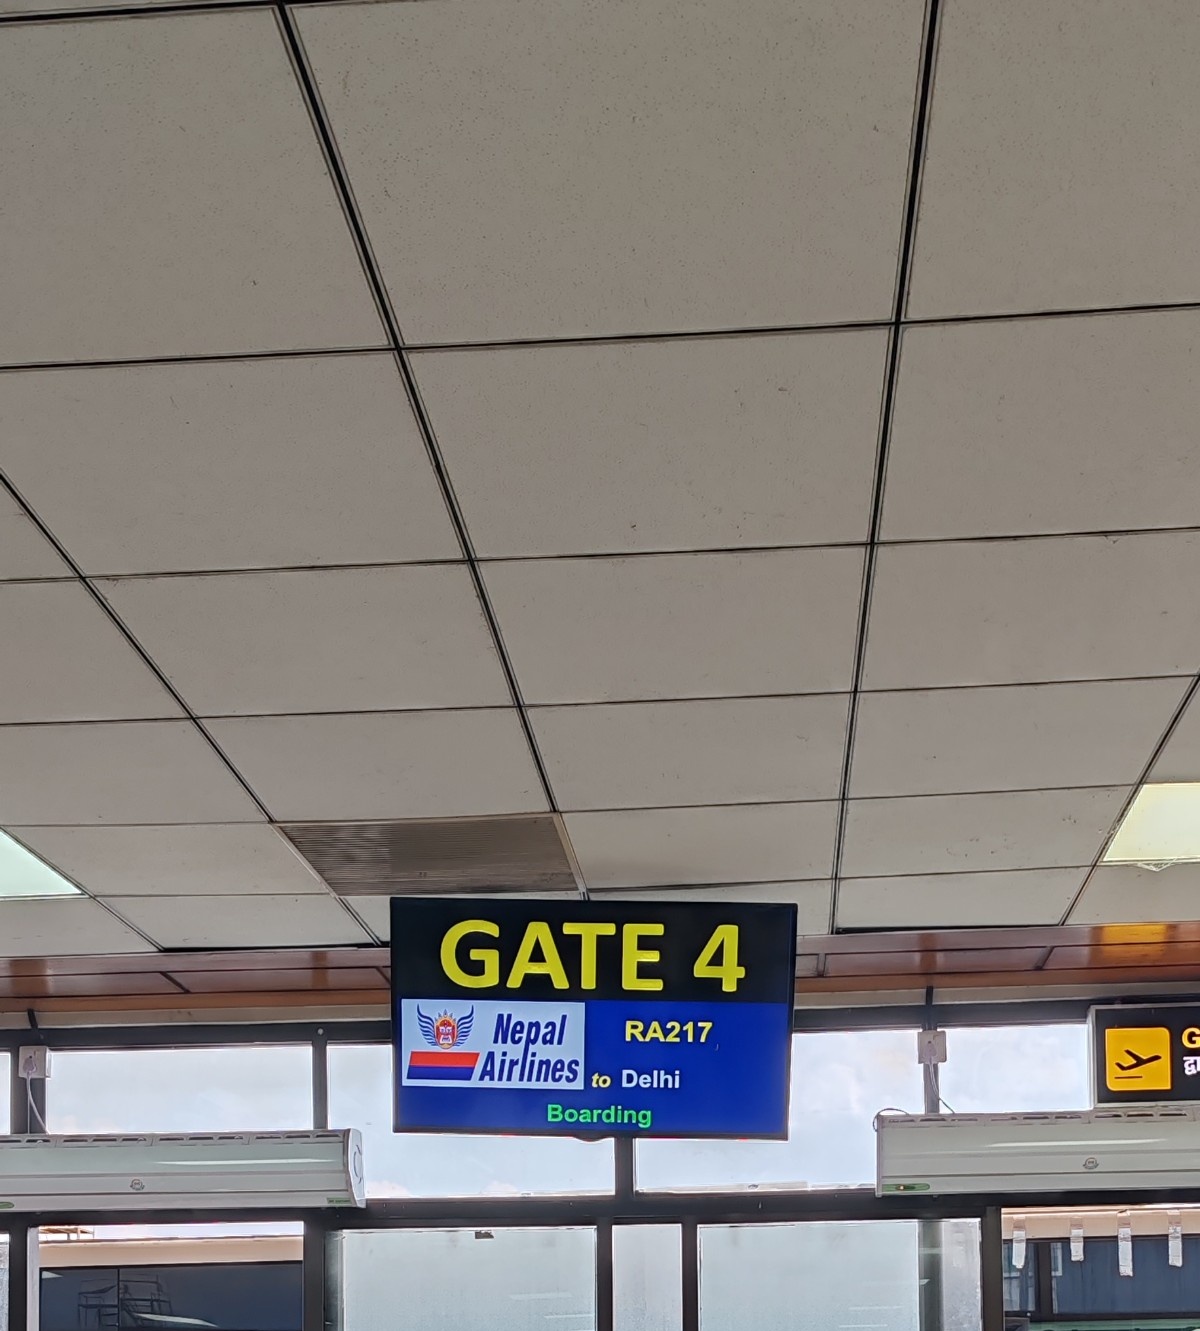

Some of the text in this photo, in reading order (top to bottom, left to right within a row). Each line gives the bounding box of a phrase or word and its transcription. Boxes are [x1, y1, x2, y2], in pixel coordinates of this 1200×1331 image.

[440, 919, 746, 993] GATE 4
[492, 1013, 567, 1050] Nepal
[625, 1020, 713, 1043] RA217
[478, 1049, 580, 1084] Airlines
[591, 1069, 680, 1089] to Delhi
[547, 1103, 652, 1128] Boarding
